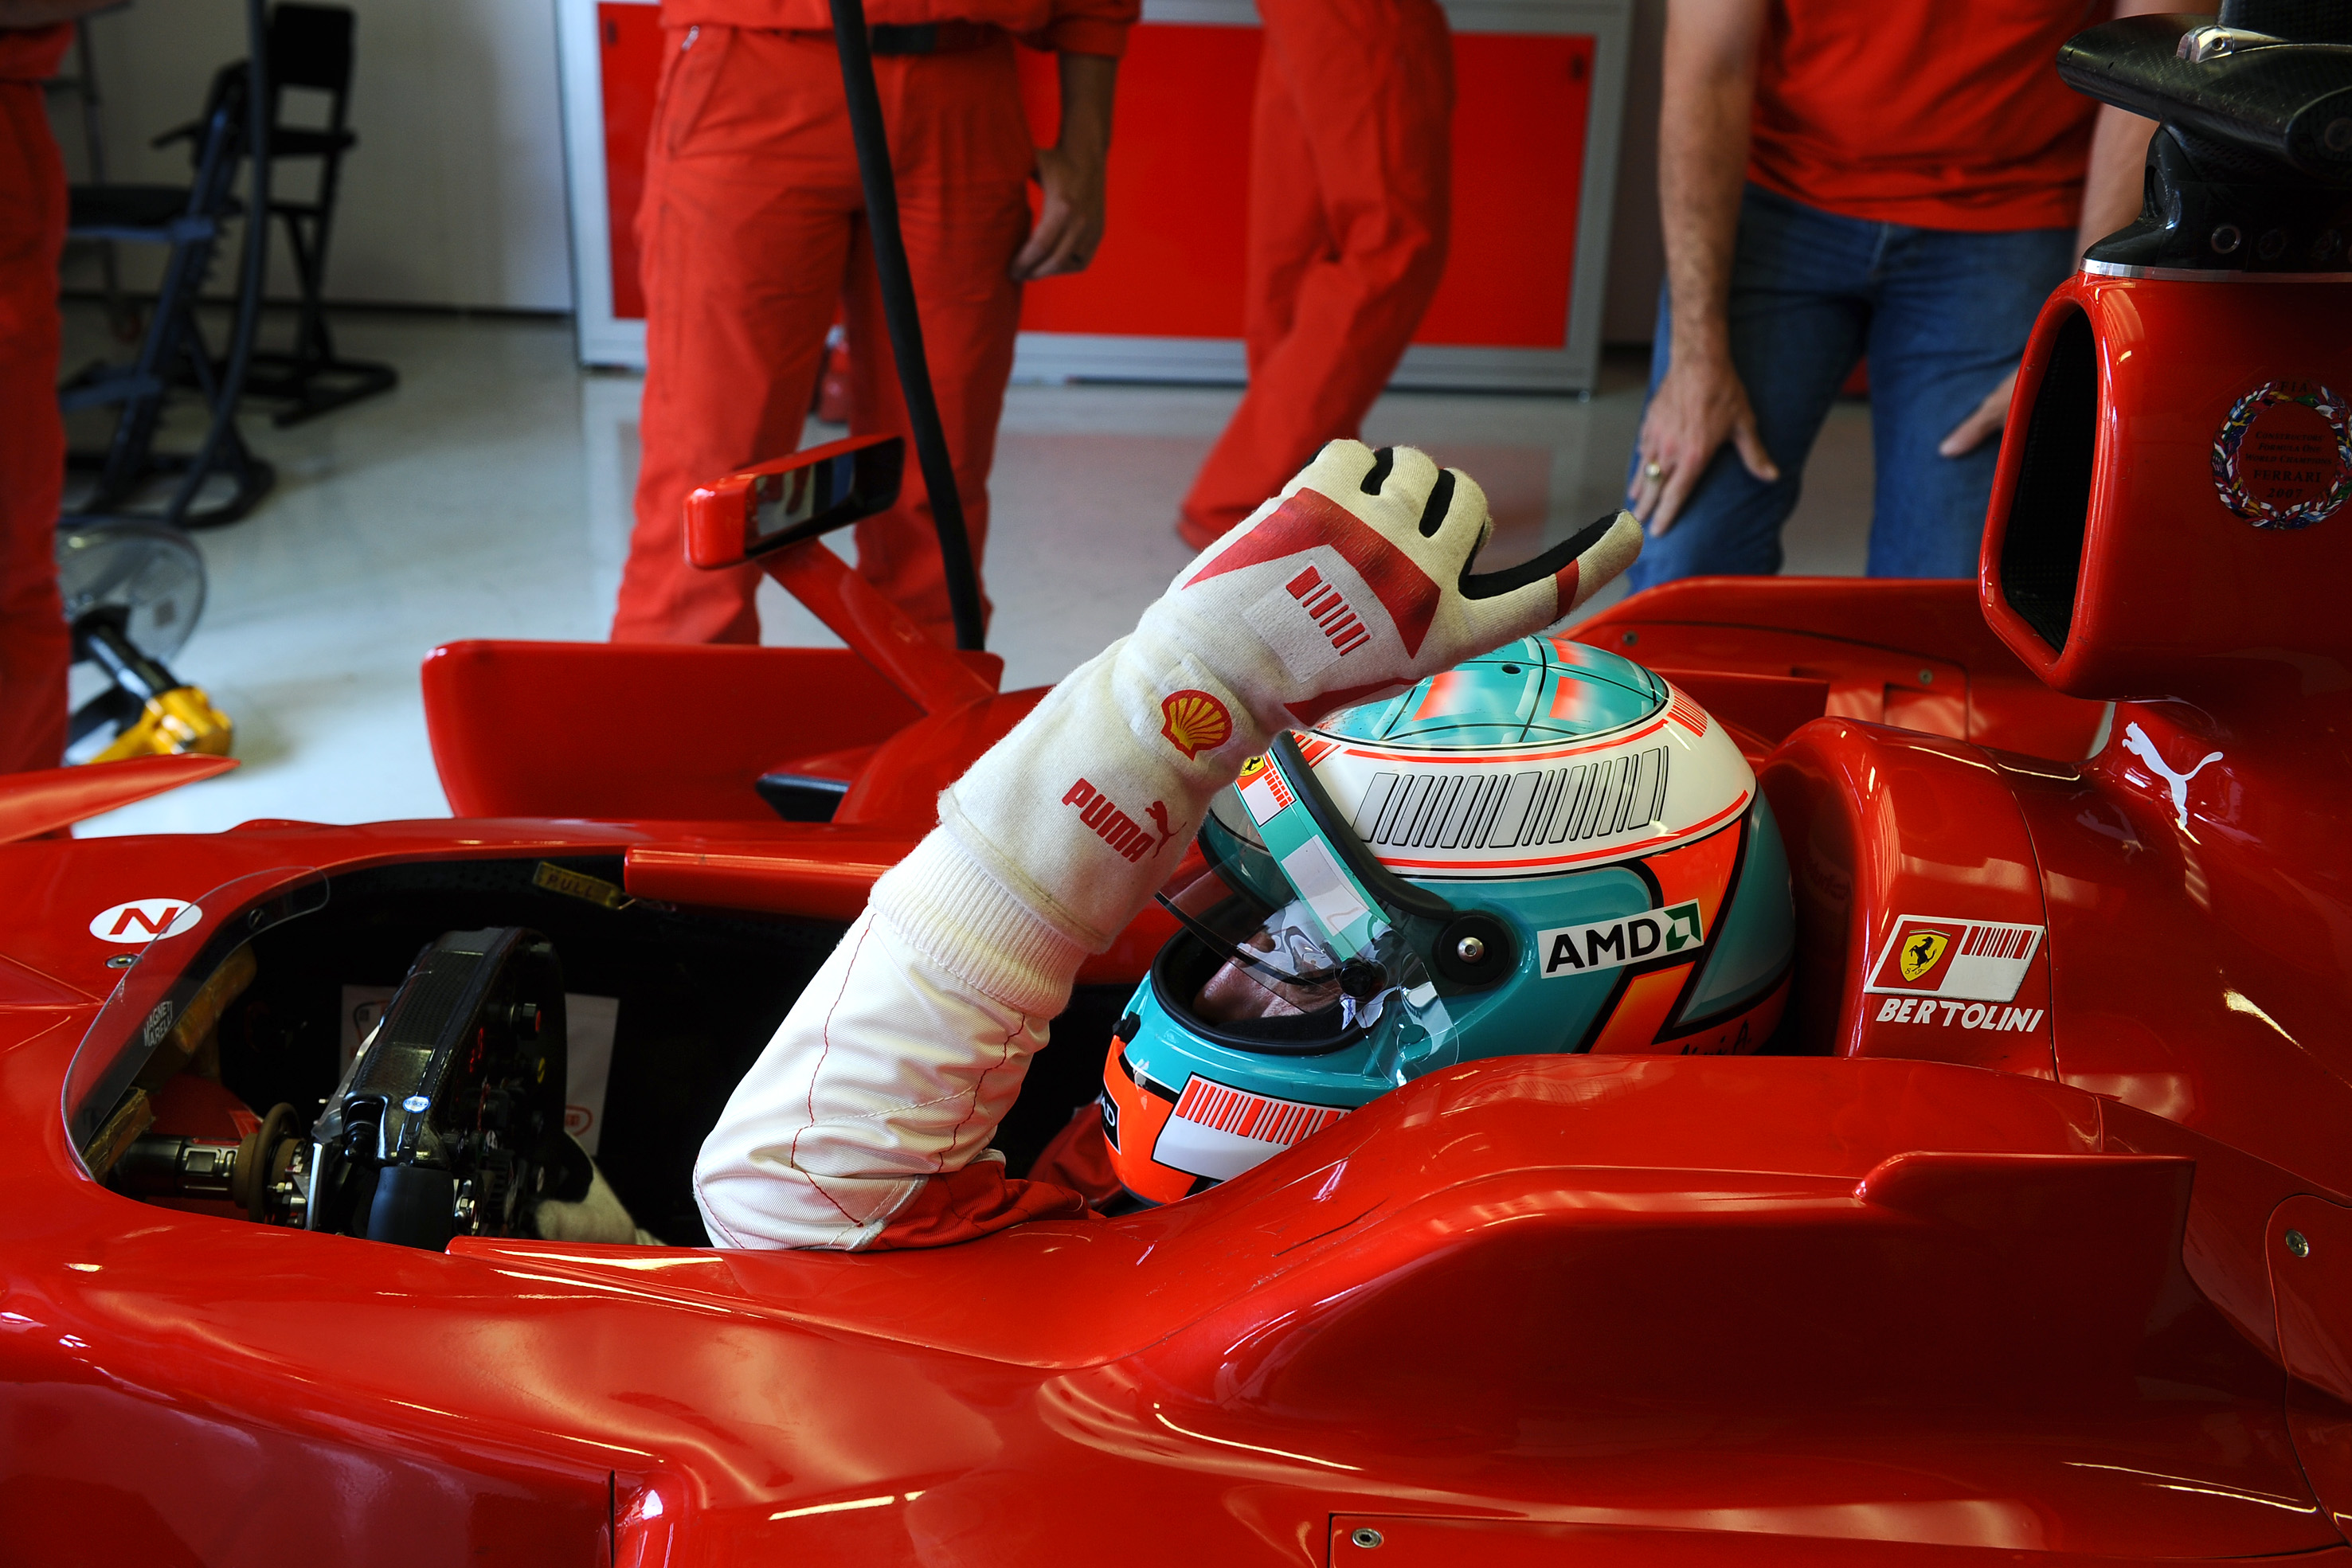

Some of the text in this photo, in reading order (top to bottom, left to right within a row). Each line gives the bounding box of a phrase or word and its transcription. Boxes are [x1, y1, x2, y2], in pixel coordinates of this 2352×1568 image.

[2280, 381, 2308, 393] FIA
[2258, 443, 2321, 452] FORMULA ONE
[2245, 453, 2333, 465] WORLD CHAMPIONS
[2254, 470, 2321, 483] FERRARI
[2267, 488, 2303, 499] 2007
[1062, 777, 1155, 862] PUMA
[546, 873, 593, 898] PULL
[108, 906, 180, 935] N
[1545, 918, 1661, 973] AMD
[1875, 998, 2045, 1032] BERTOLINI
